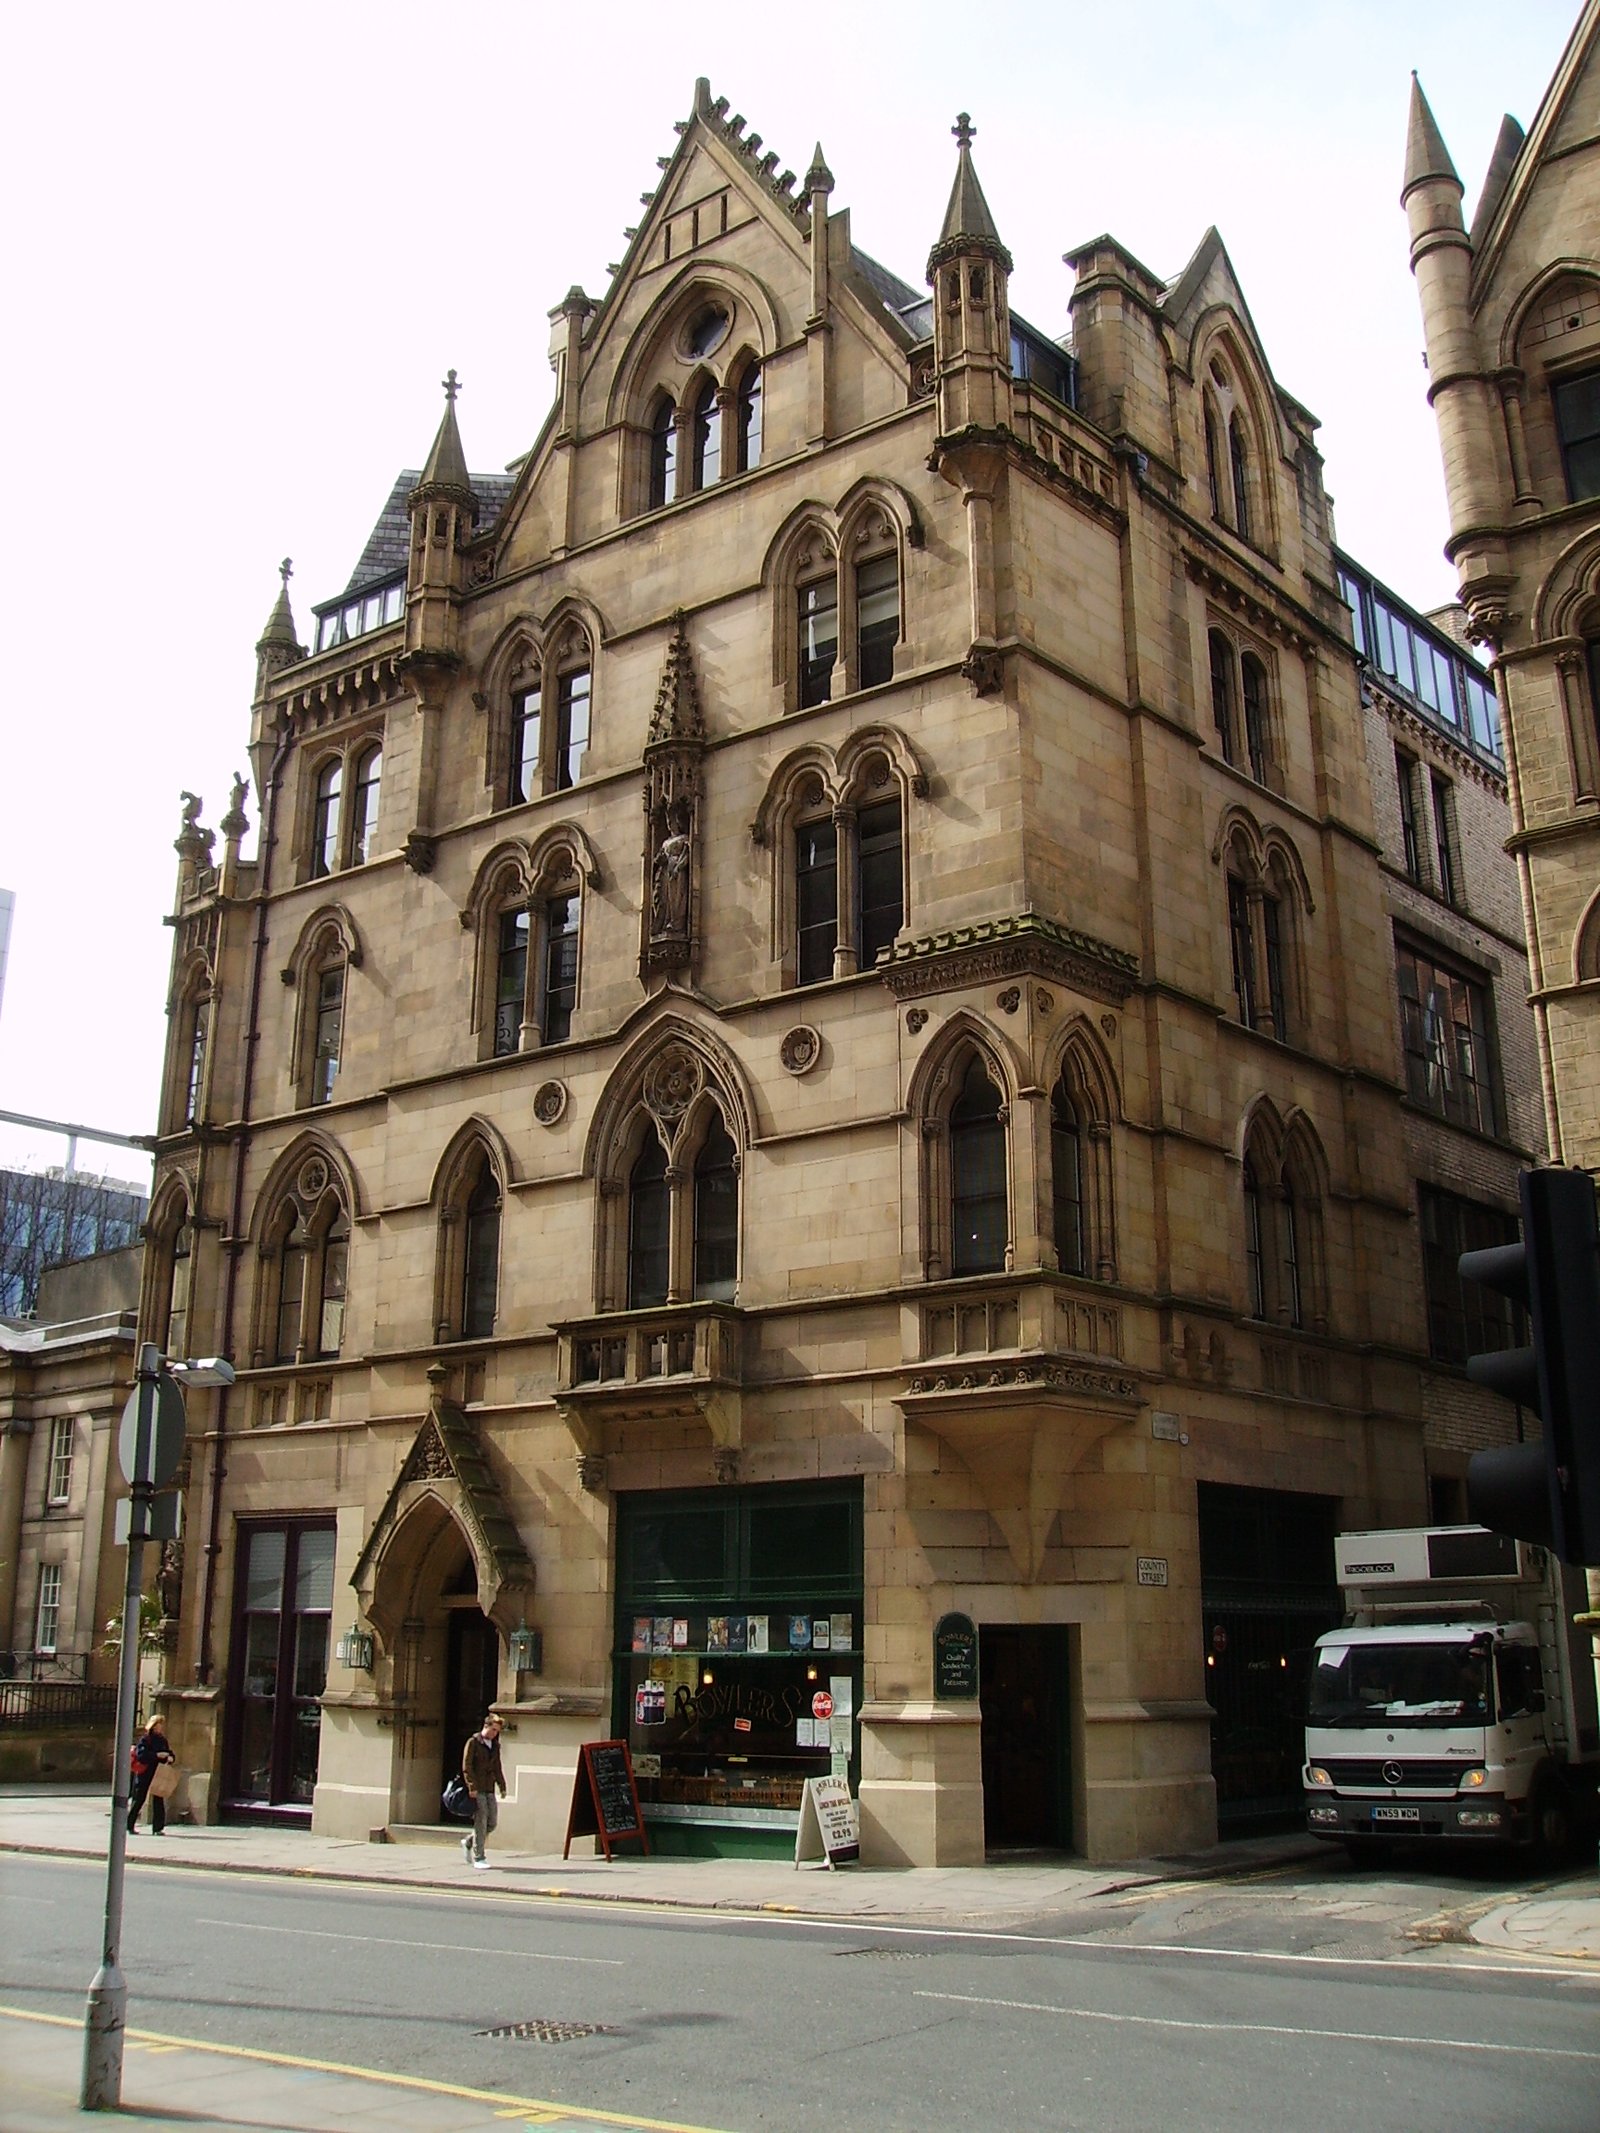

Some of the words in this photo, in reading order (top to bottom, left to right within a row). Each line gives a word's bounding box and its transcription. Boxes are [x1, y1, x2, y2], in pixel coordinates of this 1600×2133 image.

[458, 1502, 487, 1553] BUILDINGS
[1139, 1560, 1165, 1570] COUNTY
[1141, 1572, 1165, 1583] STREET
[673, 1685, 802, 1740] BOWLERS
[816, 1779, 847, 1795] BOWLERS
[1377, 1809, 1399, 1818] WN59
[832, 1828, 852, 1839] £2.95
